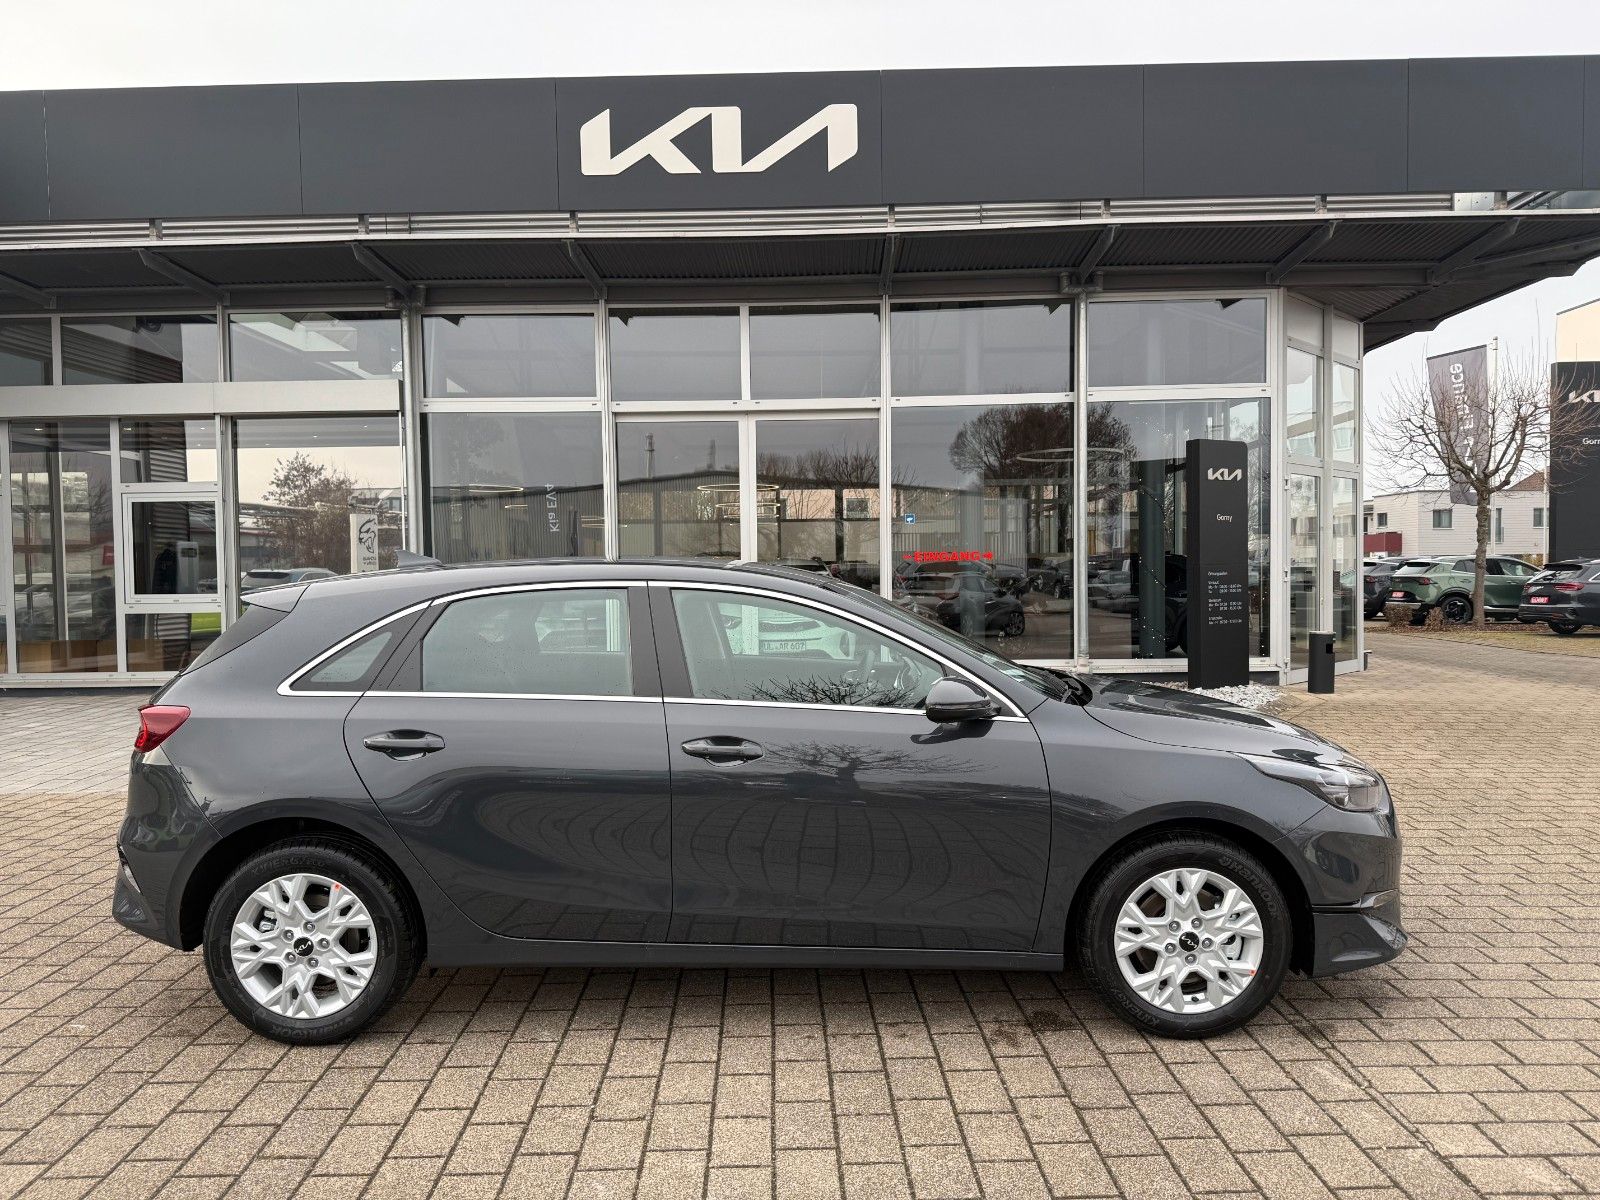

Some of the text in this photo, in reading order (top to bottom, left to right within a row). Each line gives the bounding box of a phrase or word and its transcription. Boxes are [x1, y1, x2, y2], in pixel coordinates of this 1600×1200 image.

[579, 103, 858, 176] KIA
[1207, 467, 1242, 481] KIA
[914, 551, 981, 562] EINGANG
[295, 941, 312, 953] KIA
